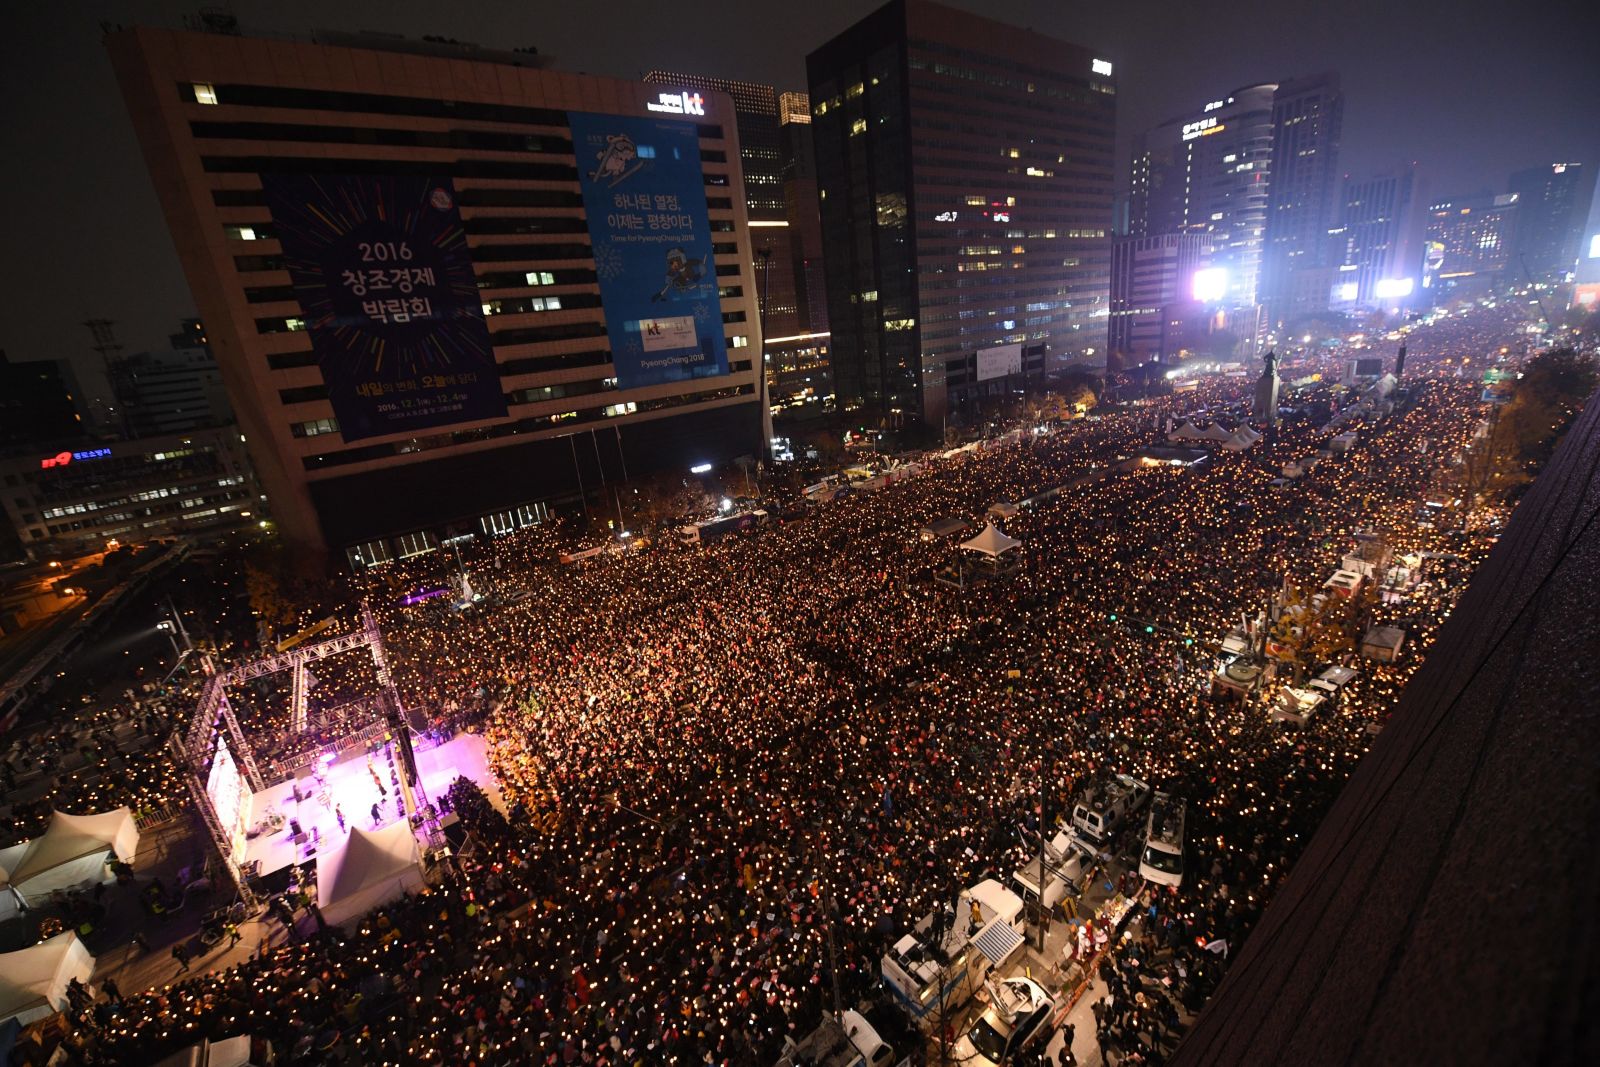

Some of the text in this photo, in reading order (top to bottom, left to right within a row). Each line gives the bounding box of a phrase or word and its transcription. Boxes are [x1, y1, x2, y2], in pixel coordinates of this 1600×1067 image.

[682, 92, 705, 116] kt
[614, 194, 681, 211] 하나된 열정,
[607, 214, 693, 230] 이제는 평창이다
[358, 241, 413, 262] 2016
[341, 267, 436, 296] 창조경제
[362, 297, 433, 325] 박람회
[647, 320, 661, 336] kt
[688, 353, 705, 362] 2018
